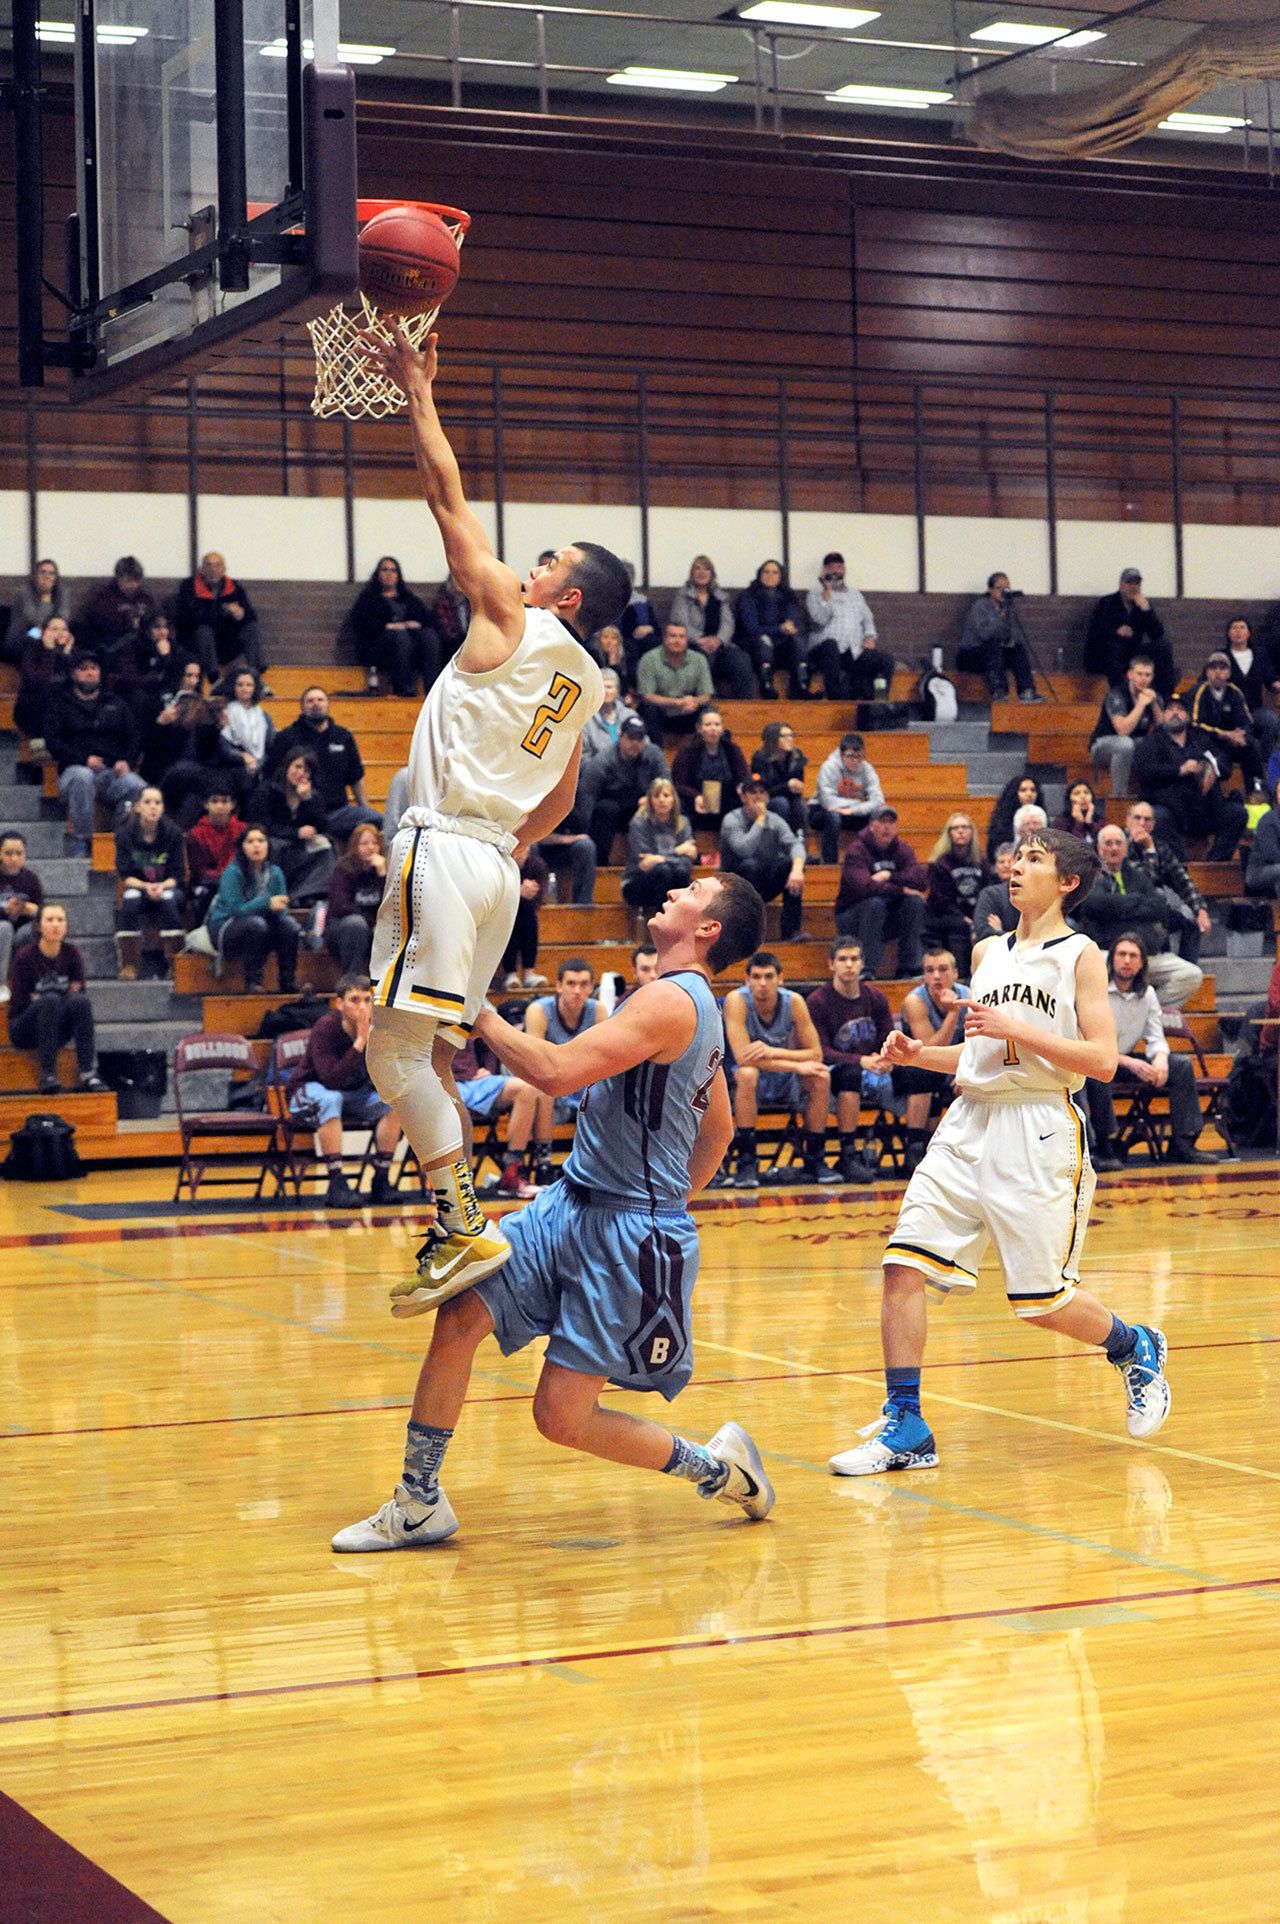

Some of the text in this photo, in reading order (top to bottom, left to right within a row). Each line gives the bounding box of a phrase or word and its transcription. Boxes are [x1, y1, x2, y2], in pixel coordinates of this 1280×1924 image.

[521, 671, 582, 759] 2
[977, 983, 1057, 1019] PARTANS
[649, 1337, 671, 1364] B
